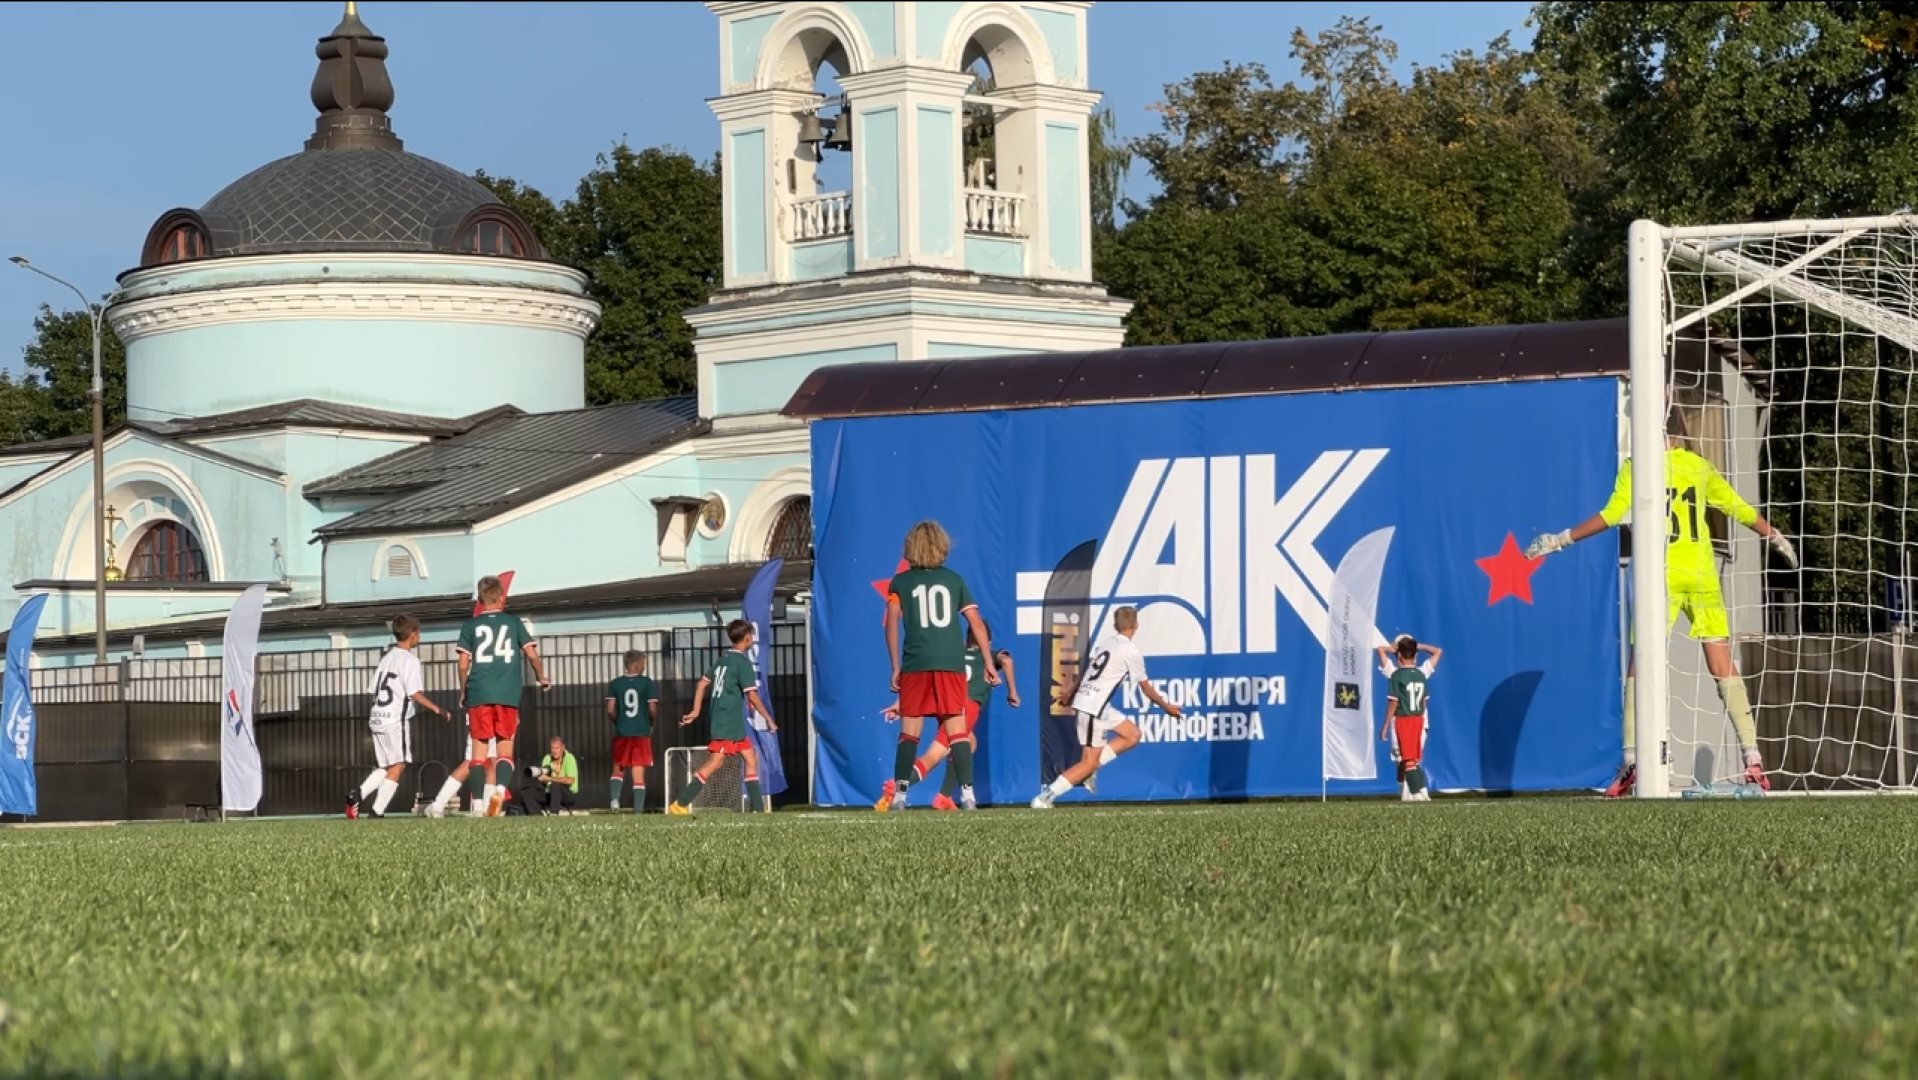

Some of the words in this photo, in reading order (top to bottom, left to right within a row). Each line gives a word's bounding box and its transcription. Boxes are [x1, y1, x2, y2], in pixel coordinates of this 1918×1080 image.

[1665, 486, 1699, 543] 31
[911, 584, 951, 628] 10
[475, 624, 515, 663] 24
[712, 665, 727, 698] 14
[1089, 650, 1110, 681] 9
[625, 688, 639, 718] 9
[1206, 674, 1287, 707] ИГОРЯ
[1406, 681, 1425, 711] 17
[1127, 710, 1265, 743] КИНФЕЕВА
